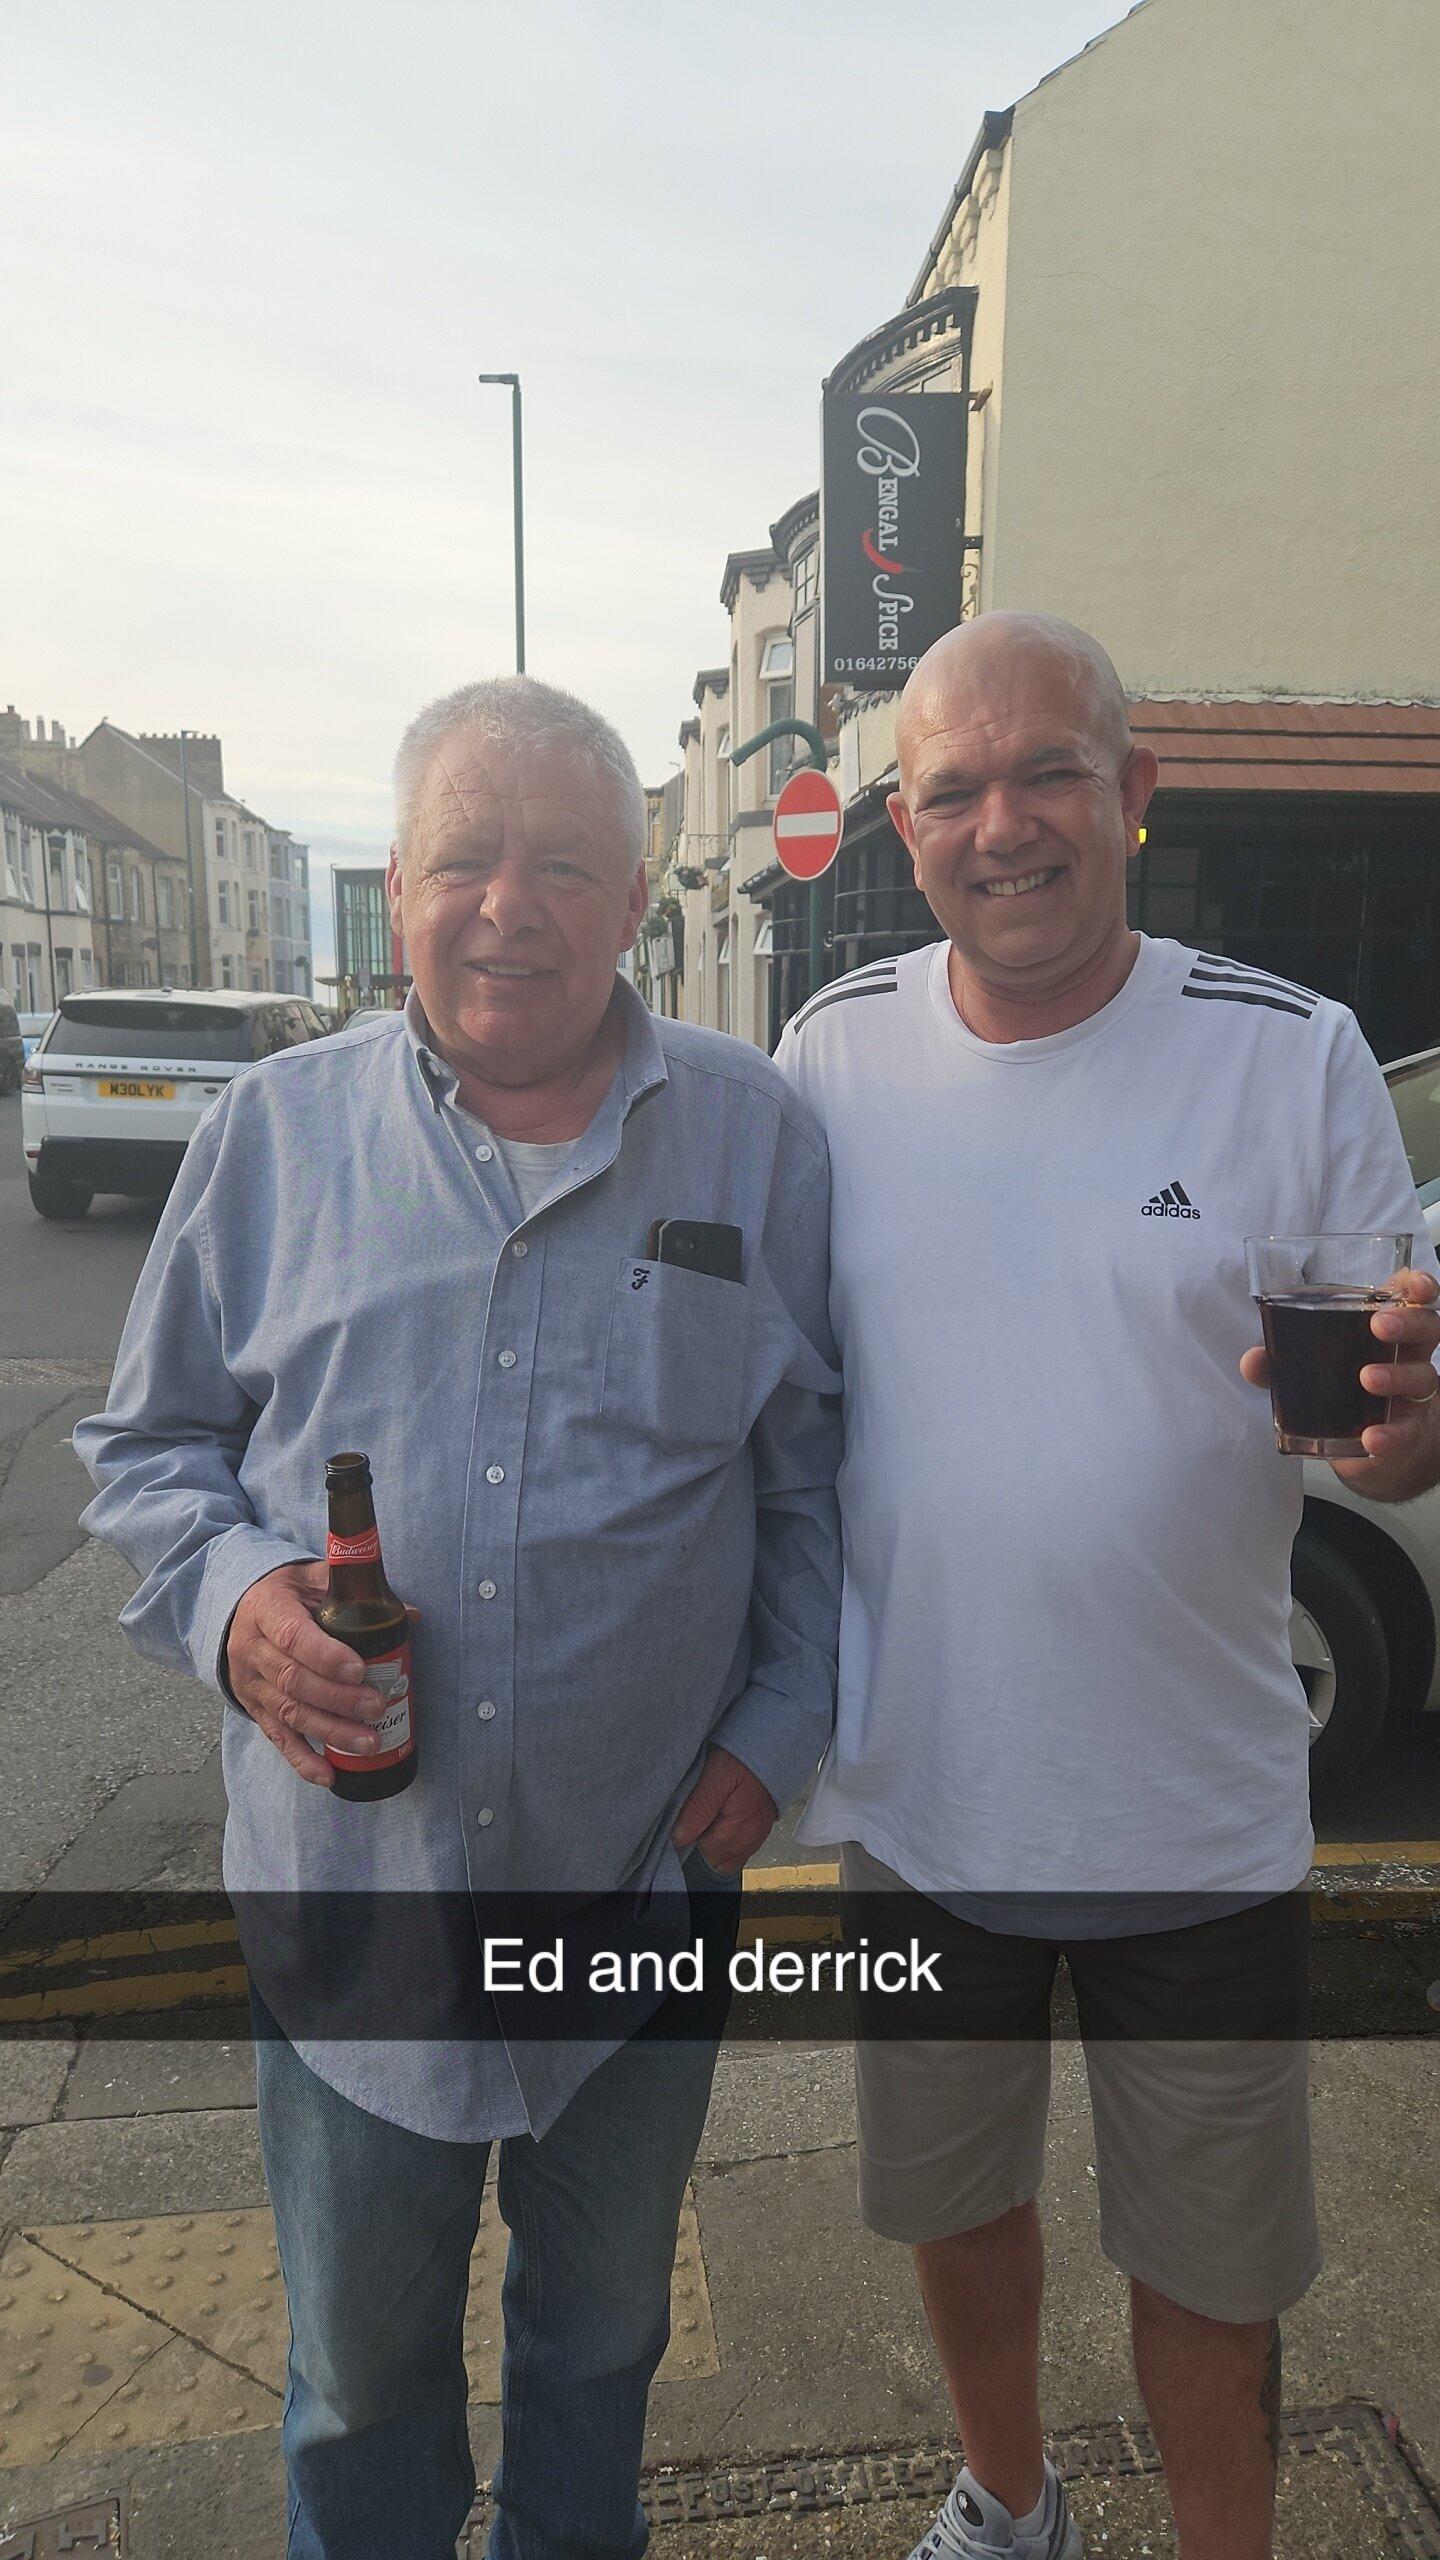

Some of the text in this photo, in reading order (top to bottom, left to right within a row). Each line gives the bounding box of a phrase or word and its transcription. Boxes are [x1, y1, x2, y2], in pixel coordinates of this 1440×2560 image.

[856, 406, 920, 651] BENGAL SPICE
[833, 656, 922, 671] 01642756
[75, 1062, 198, 1073] RANGE ROVER
[1141, 1202, 1201, 1219] adidas
